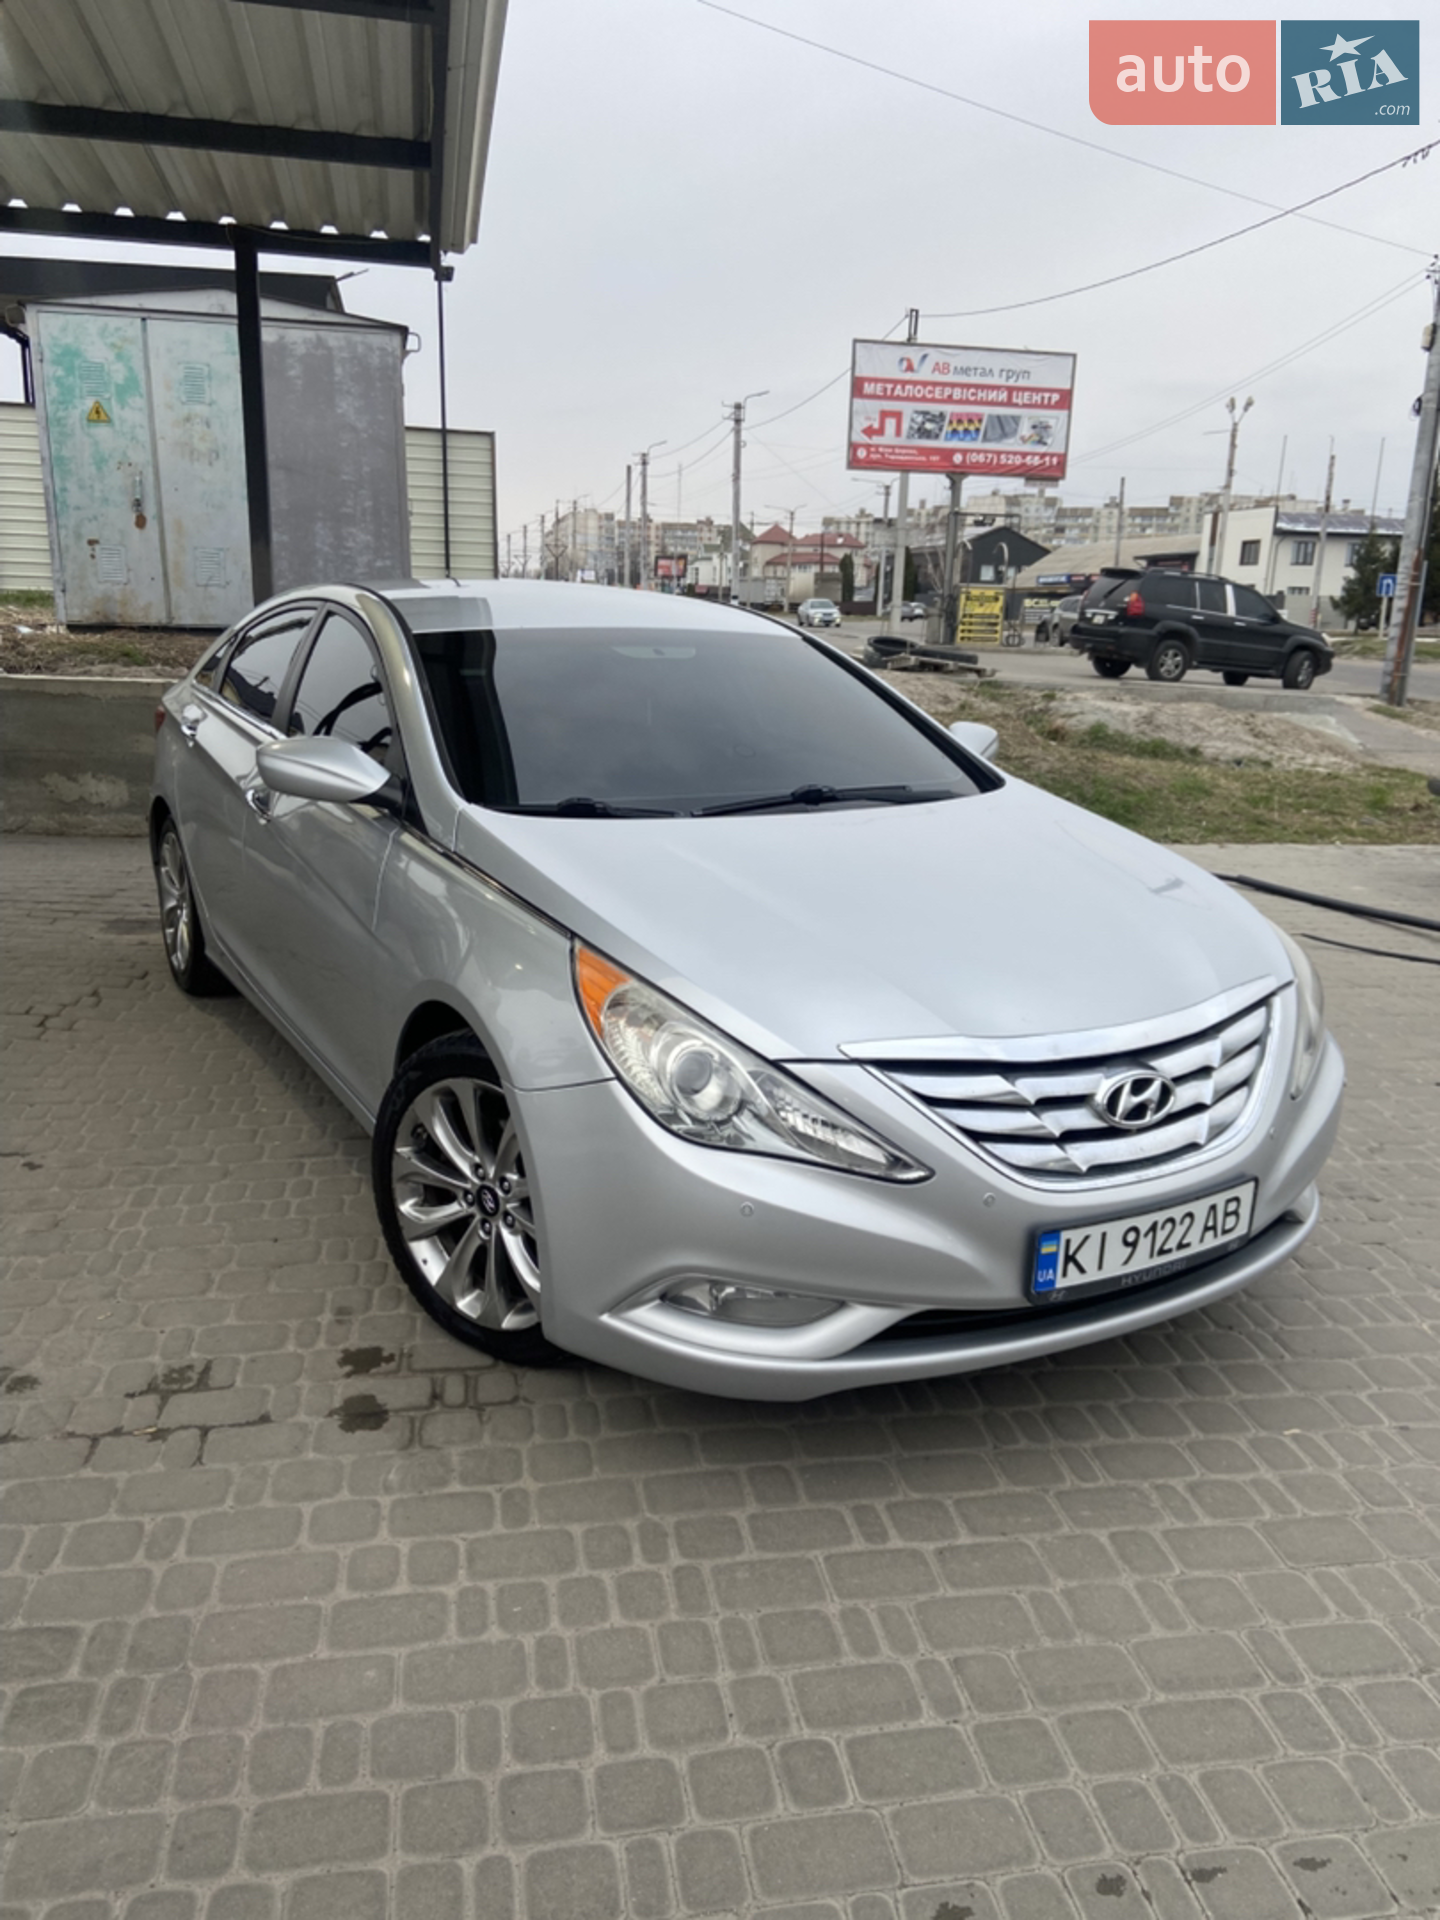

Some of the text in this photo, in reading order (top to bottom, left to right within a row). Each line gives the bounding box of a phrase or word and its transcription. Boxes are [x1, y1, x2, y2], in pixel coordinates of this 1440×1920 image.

[953, 365, 994, 378] метал
[999, 368, 1031, 383] груп
[863, 381, 1060, 406] МЕТАЛОСЕРВІСНИЙ ЦЕНТР
[1061, 1195, 1242, 1279] KI 9122 AB
[1038, 1269, 1055, 1283] UA
[1120, 1260, 1187, 1287] HYUNDAI
